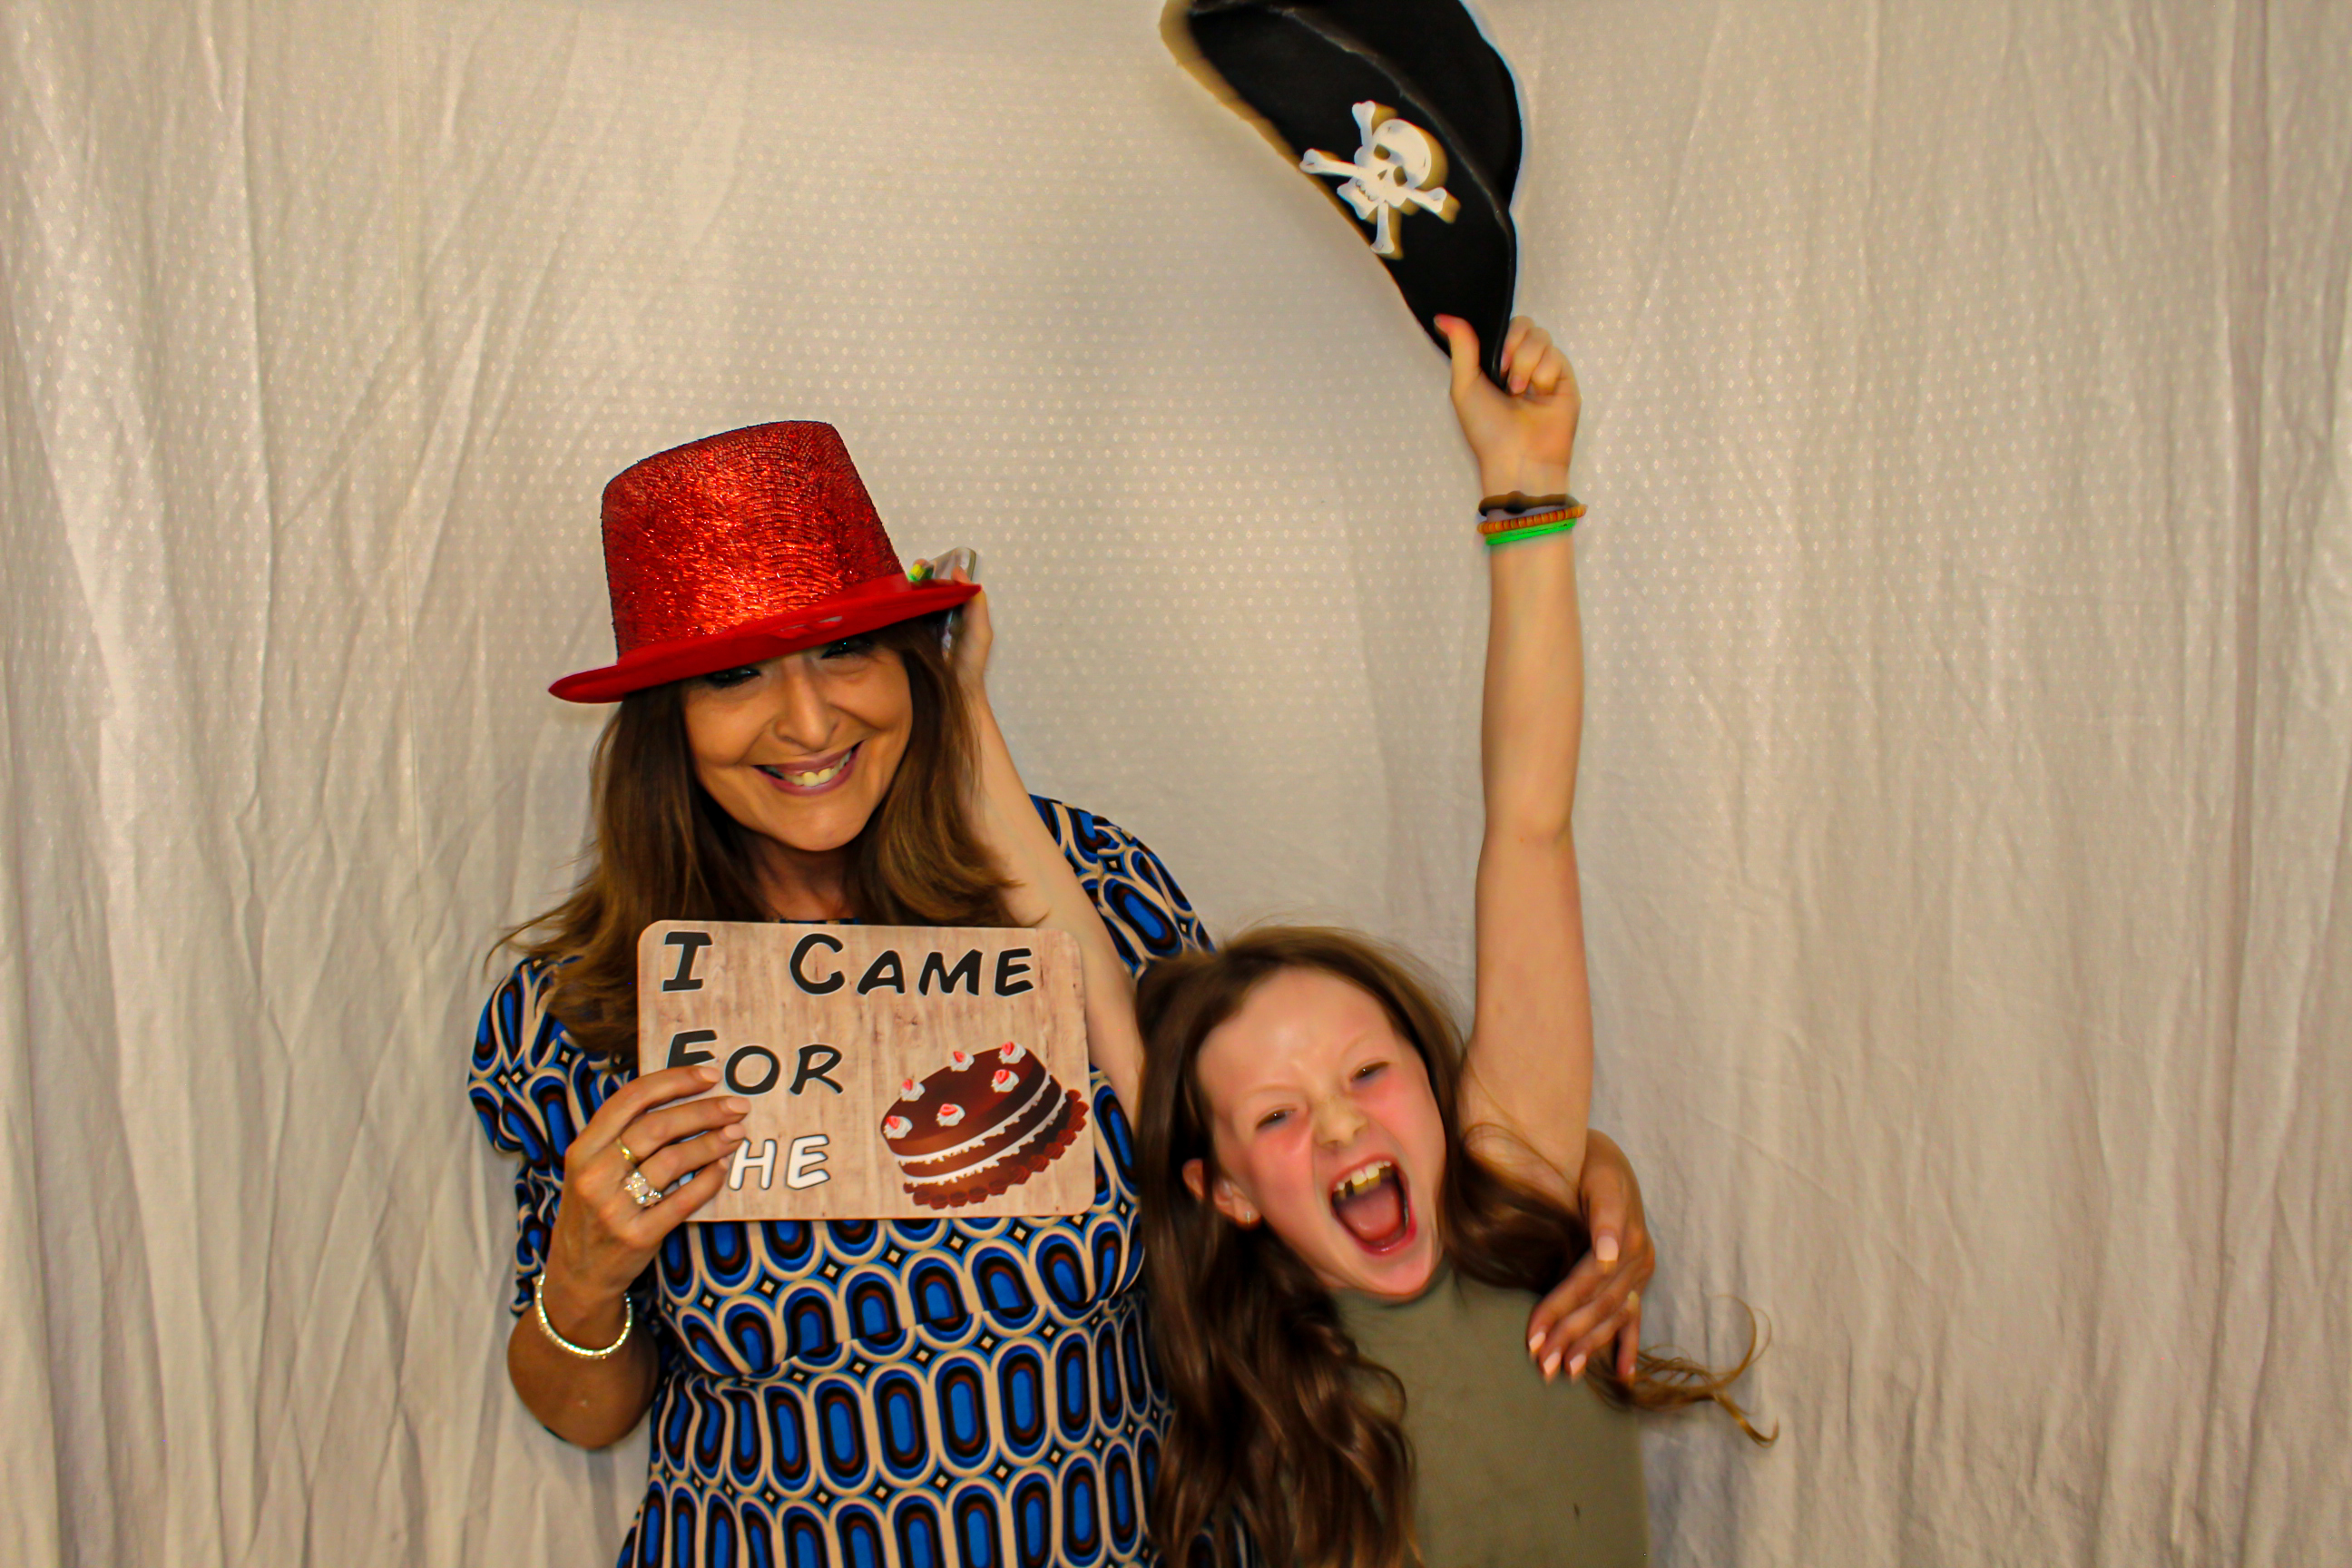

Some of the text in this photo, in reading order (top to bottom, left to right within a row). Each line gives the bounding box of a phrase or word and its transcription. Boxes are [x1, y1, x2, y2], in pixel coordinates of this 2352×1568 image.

[662, 931, 1034, 996] I CAME
[679, 1133, 830, 1191] HE
